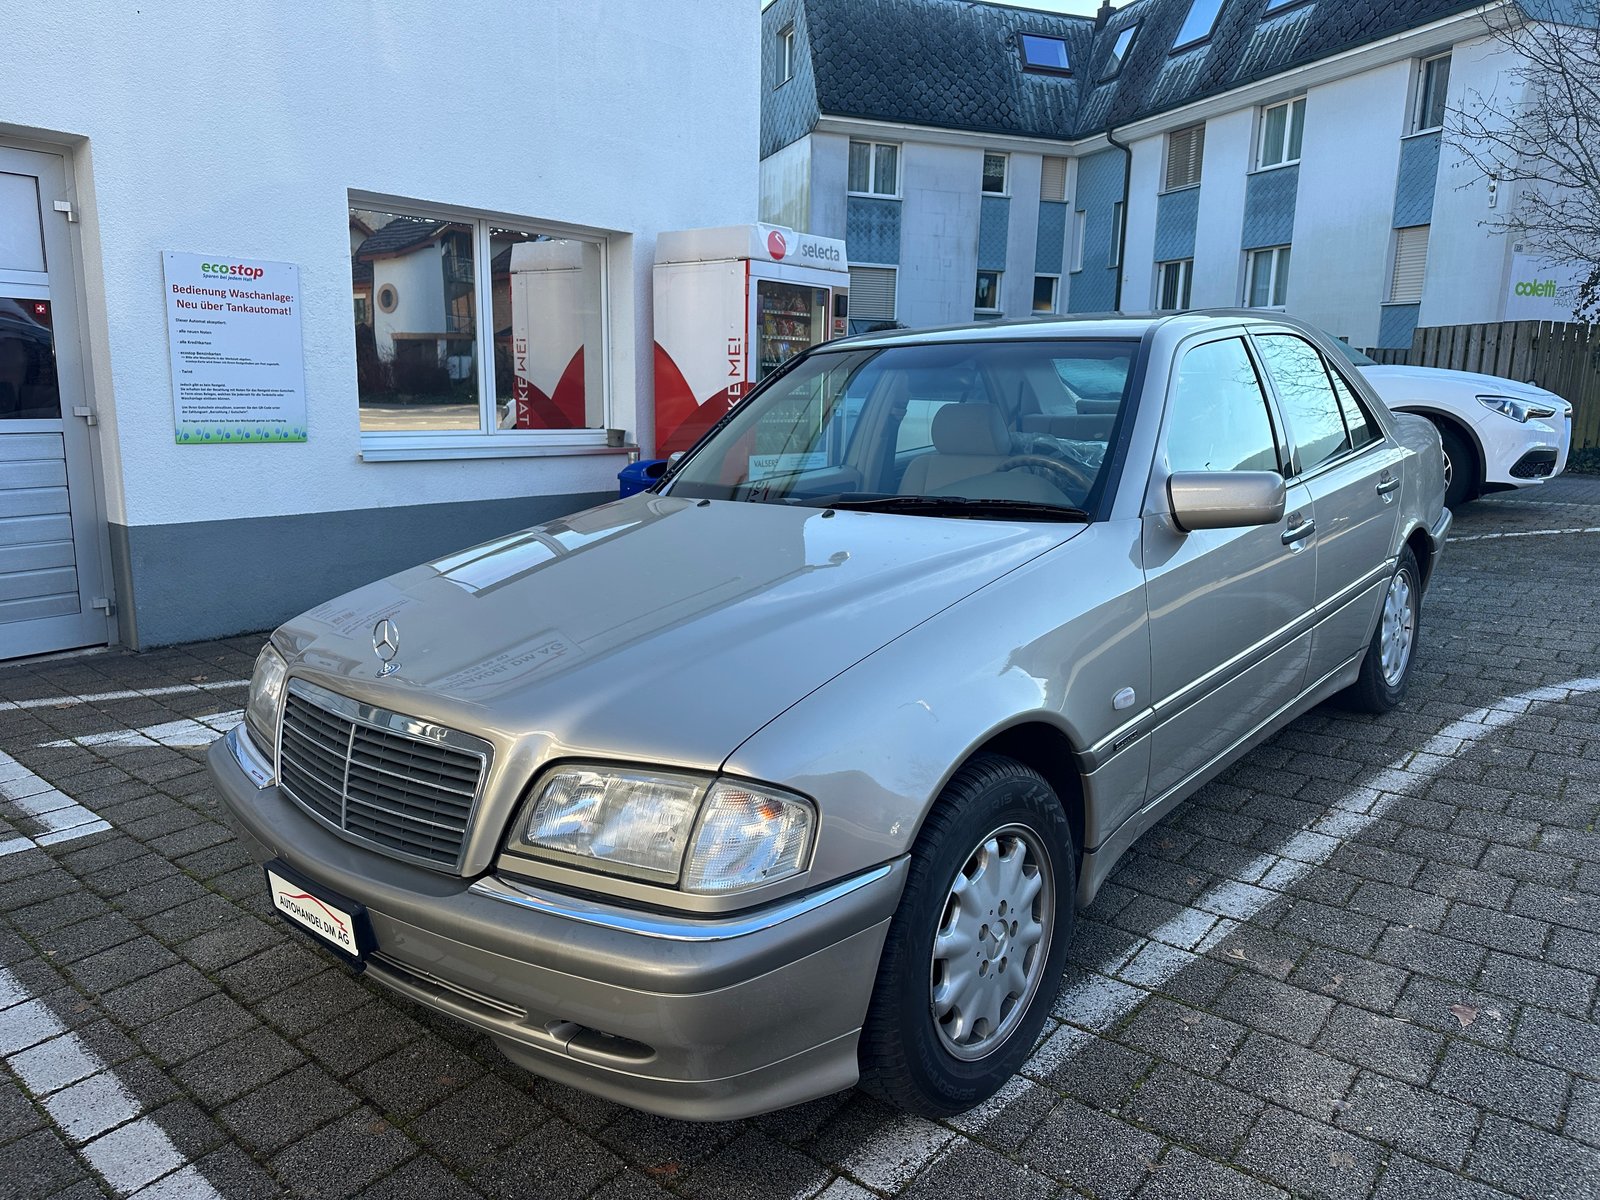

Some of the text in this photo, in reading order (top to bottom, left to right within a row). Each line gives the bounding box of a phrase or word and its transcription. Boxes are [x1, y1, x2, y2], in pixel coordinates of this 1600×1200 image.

[802, 242, 840, 262] selecta
[201, 262, 264, 280] ecostop
[172, 284, 294, 304] Bedienung Waschanlage:
[1514, 278, 1556, 298] coletti
[176, 299, 292, 316] Neu über Tankautomat!
[728, 338, 741, 377] ME!
[280, 896, 350, 945] AUTOHANDEL DM AG
